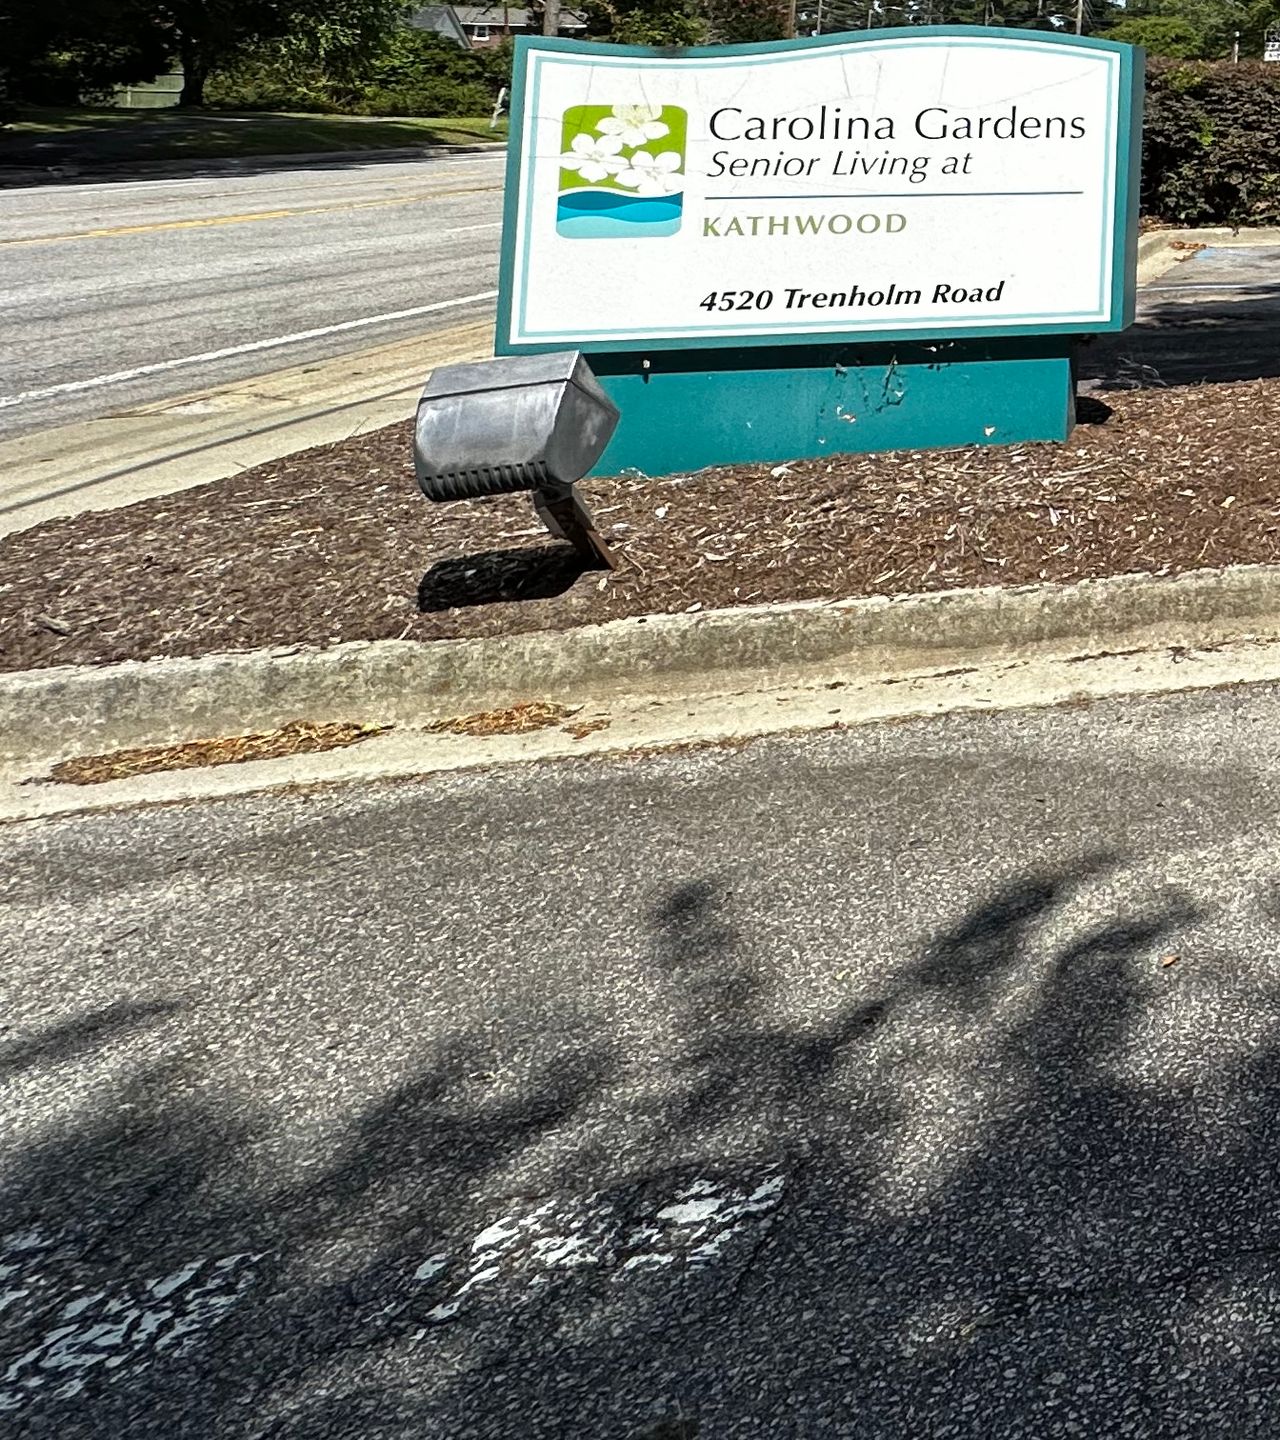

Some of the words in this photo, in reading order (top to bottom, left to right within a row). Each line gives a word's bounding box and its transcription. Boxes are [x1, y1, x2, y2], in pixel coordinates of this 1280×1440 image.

[709, 105, 896, 141] Carolina
[914, 105, 1086, 140] Gardens
[706, 150, 821, 178] Senior
[832, 150, 932, 184] Living
[941, 152, 973, 175] at
[702, 213, 907, 237] KATHWOOD
[699, 289, 774, 312] 4520
[784, 283, 922, 309] Trenholm
[931, 280, 1006, 304] Road
